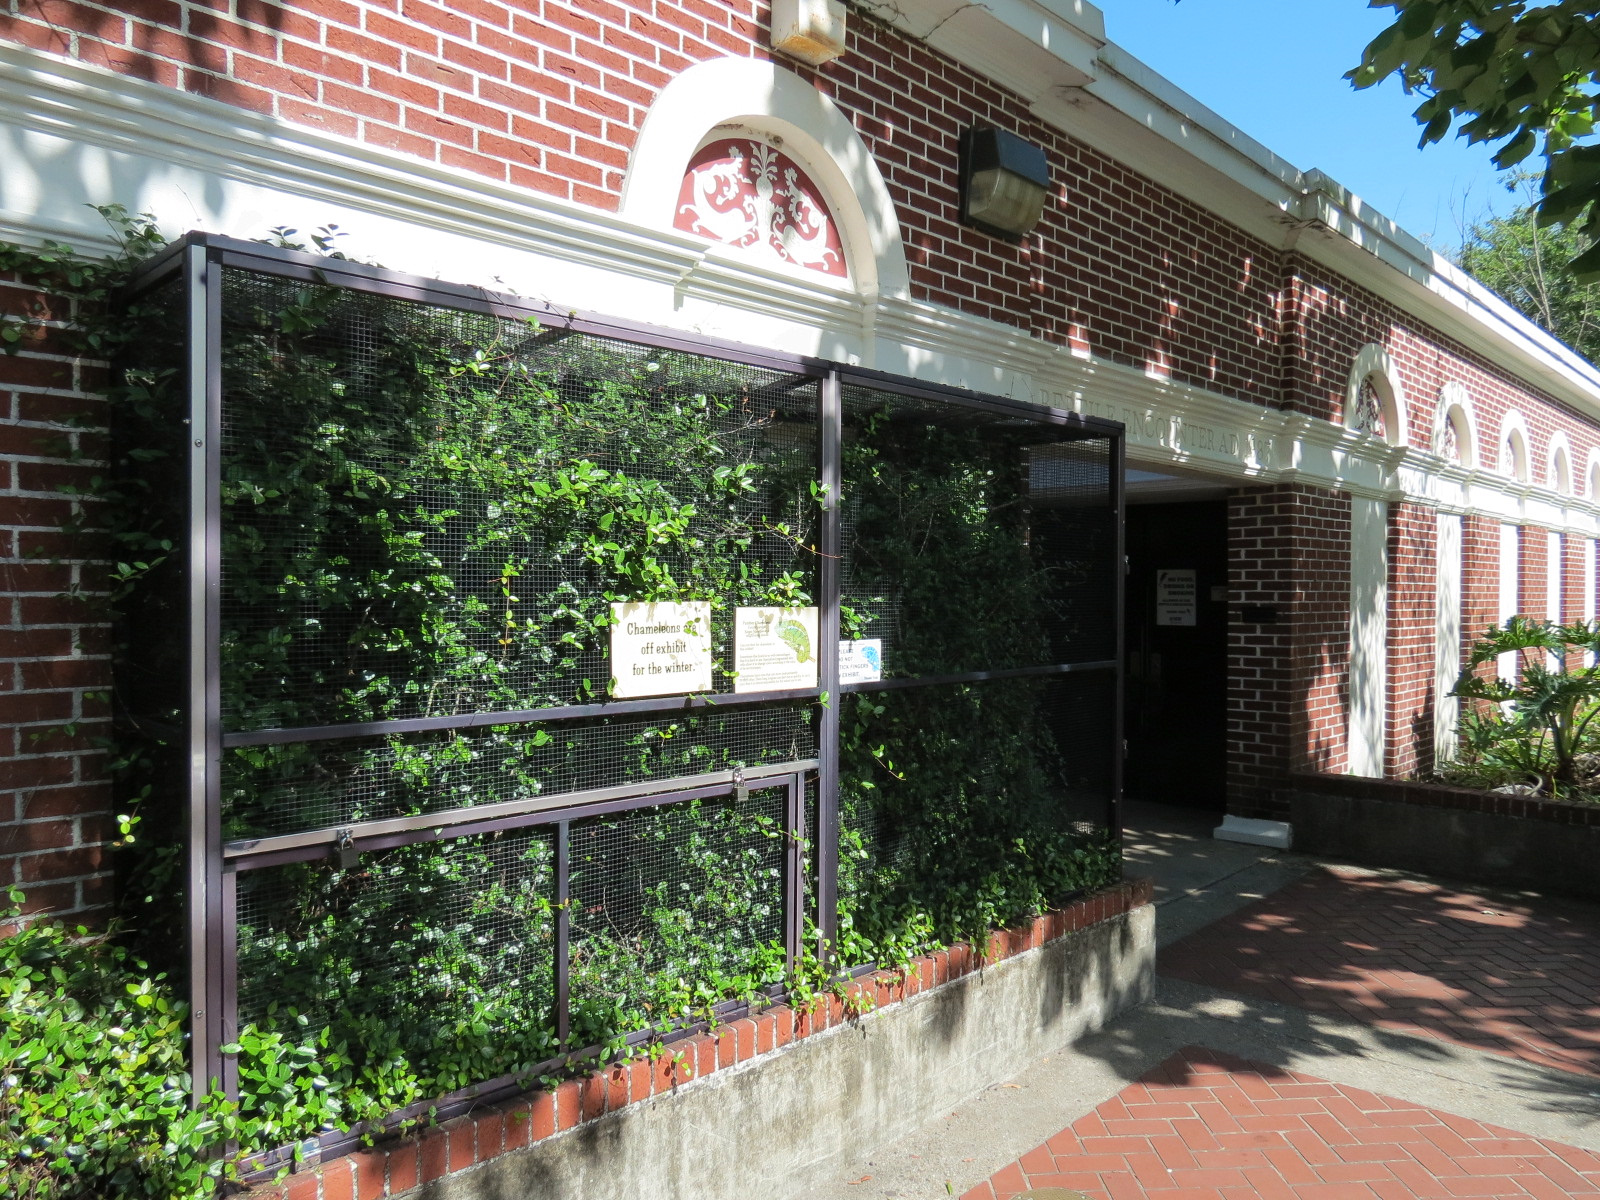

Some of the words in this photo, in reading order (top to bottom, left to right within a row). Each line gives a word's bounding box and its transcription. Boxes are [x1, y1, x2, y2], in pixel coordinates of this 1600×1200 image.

[1122, 408, 1215, 452] ENCOUNTER
[627, 621, 681, 635] Chameleons
[641, 642, 654, 655] off
[656, 641, 687, 655] exhibit
[632, 663, 646, 676] for
[648, 662, 662, 675] the
[665, 662, 696, 674] winter.
